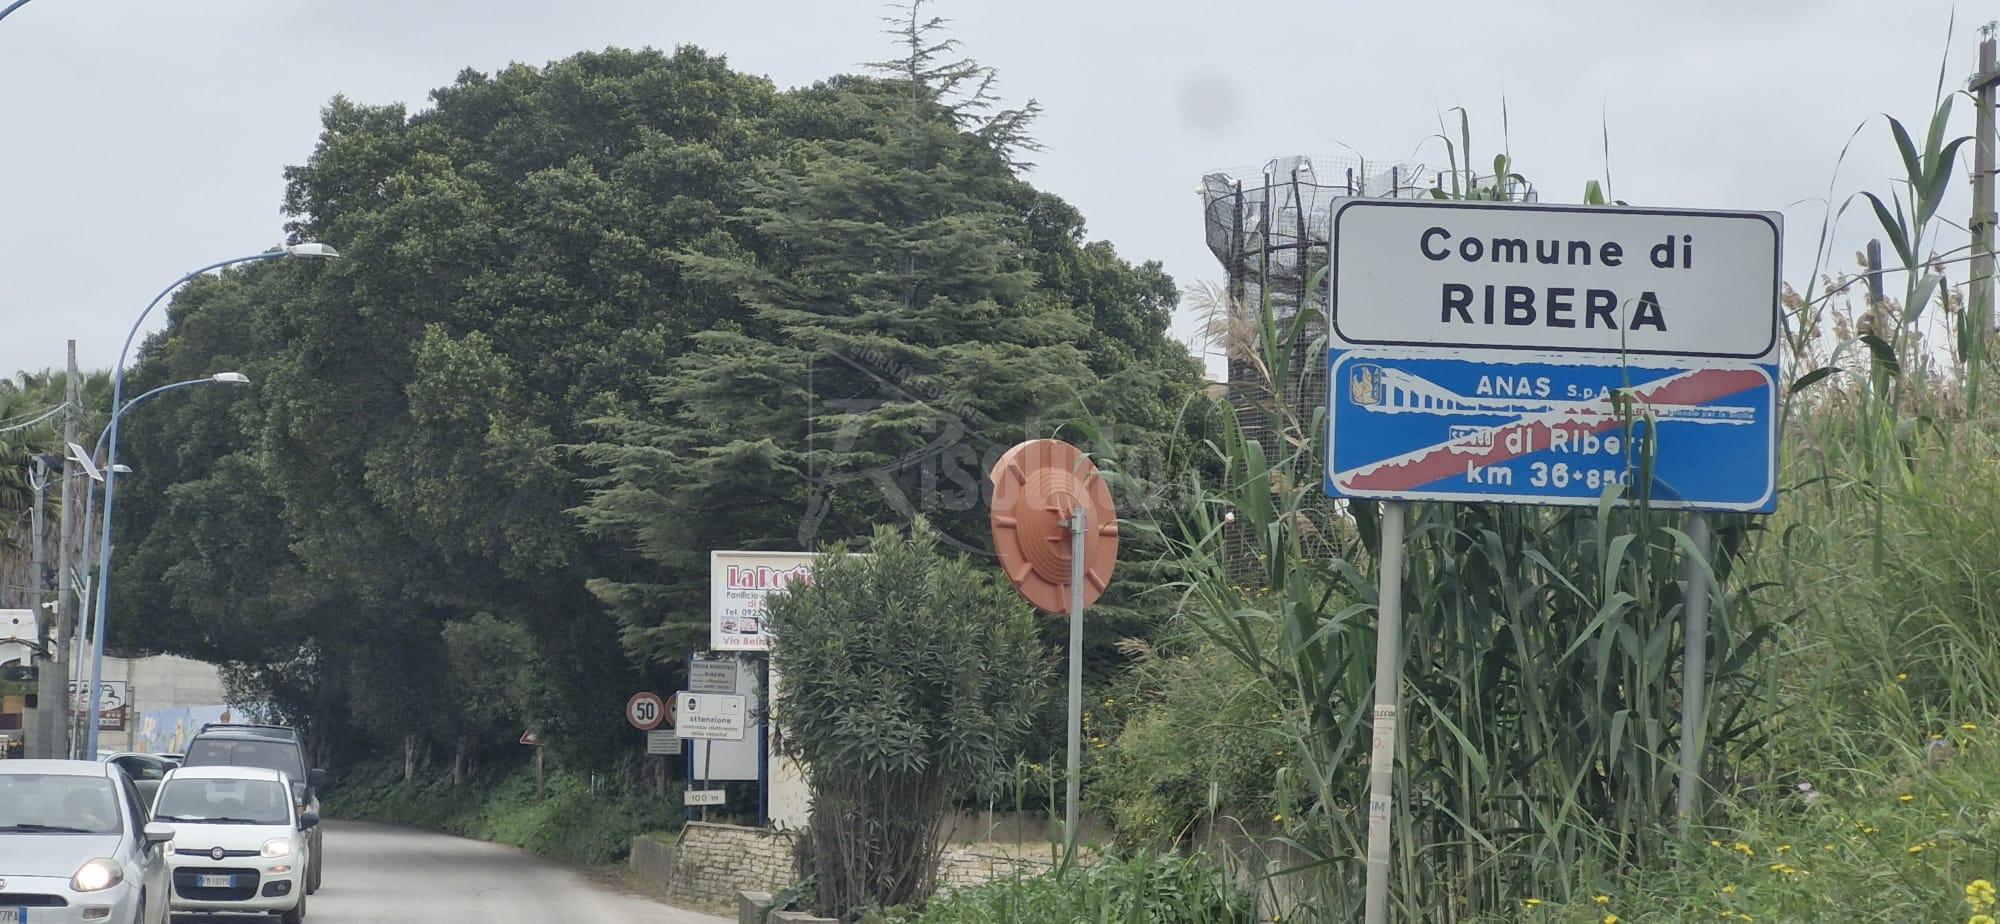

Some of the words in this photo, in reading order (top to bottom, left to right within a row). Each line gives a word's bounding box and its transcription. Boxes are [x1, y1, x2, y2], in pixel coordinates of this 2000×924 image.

[1420, 226, 1624, 267] Comune
[1650, 234, 1693, 269] di
[1440, 282, 1668, 332] RIBERA
[1476, 375, 1552, 399] ANAS
[1505, 427, 1533, 454] di
[1467, 460, 1512, 486] km
[727, 564, 755, 590] La
[726, 591, 758, 600] Panificio
[723, 636, 740, 645] Via
[636, 702, 655, 721] 50
[689, 716, 732, 724] attenzione
[691, 794, 708, 802] 100
